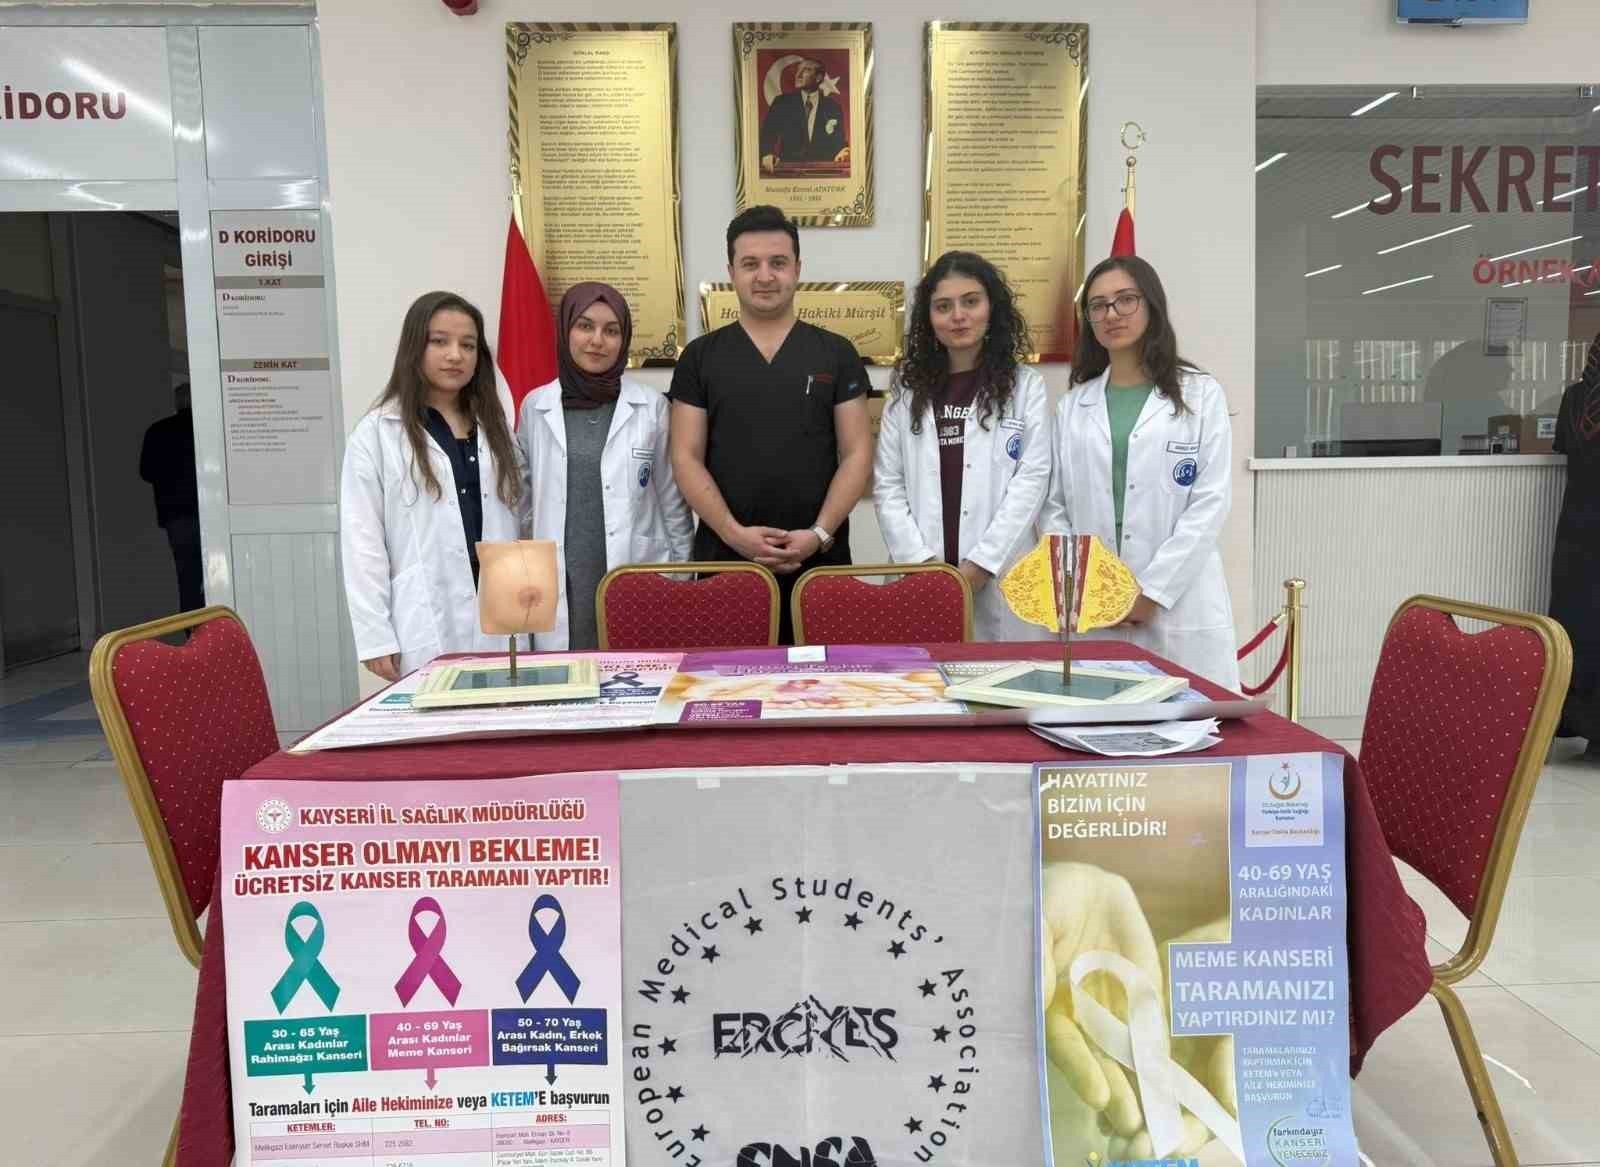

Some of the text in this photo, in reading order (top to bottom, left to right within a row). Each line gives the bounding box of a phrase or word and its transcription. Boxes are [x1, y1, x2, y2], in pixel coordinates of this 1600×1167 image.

[0, 85, 126, 119] İDORU
[1368, 145, 1600, 214] SEKRET
[219, 227, 316, 244] D KORİDORU
[245, 250, 293, 269] GİRİŞİ
[1473, 253, 1579, 284] ÖRNEK
[222, 293, 230, 301] D
[281, 360, 297, 369] KAT
[227, 375, 236, 383] D
[1047, 772, 1148, 789] HAYATINIZ
[300, 799, 585, 825] KAYSERİ İL SAĞLIK MÜDÜRLÜĞÜ
[1048, 795, 1146, 816] BİZİM İÇİN
[1048, 820, 1167, 840] DEĞERLİDİR!
[244, 838, 599, 870] KANSER OLMAYI BEKLEME!
[234, 867, 609, 896] ÜCRETSİZ KANSER TARAMANI YAPTIR!
[1237, 863, 1332, 884] 40-69 YAŞ
[1239, 884, 1333, 898] ARALIĞINDAKİ
[1239, 906, 1332, 921] KADINLAR
[638, 888, 753, 1003] Medical
[1175, 945, 1333, 968] MEME KANSERİ
[1176, 980, 1335, 1002] TARAMANIZI
[396, 1022, 412, 1031] 40
[424, 1021, 438, 1031] 69
[442, 1020, 462, 1031] Yaş
[517, 1018, 533, 1027] 50
[544, 1018, 558, 1027] 70
[562, 1017, 582, 1028] Yaş
[1177, 1010, 1336, 1028] YAPTIRDINIZ MI?
[272, 1029, 287, 1038] 30
[300, 1028, 315, 1037] 65
[319, 1026, 339, 1037] Yaş
[388, 1033, 472, 1045] Arası Kadınlar
[497, 1030, 603, 1041] Arası Kadın, Erkek
[264, 1039, 348, 1051] Arası Kadınlar
[387, 1046, 472, 1058] Meme Kanseri
[502, 1043, 598, 1054] Bağırsak Kanseri
[251, 1050, 362, 1064] Rahimağzı Kanseri
[914, 967, 980, 1162] Association
[630, 1022, 702, 1167] European
[249, 1090, 610, 1118] Taramaları için Aile Hekiminize veya KETEM'E başvurun
[414, 1118, 450, 1128] TEL. NO:
[535, 1113, 567, 1123] ADRES:
[287, 1122, 336, 1132] KETEMLER:
[1273, 1127, 1324, 1137] farkındayız
